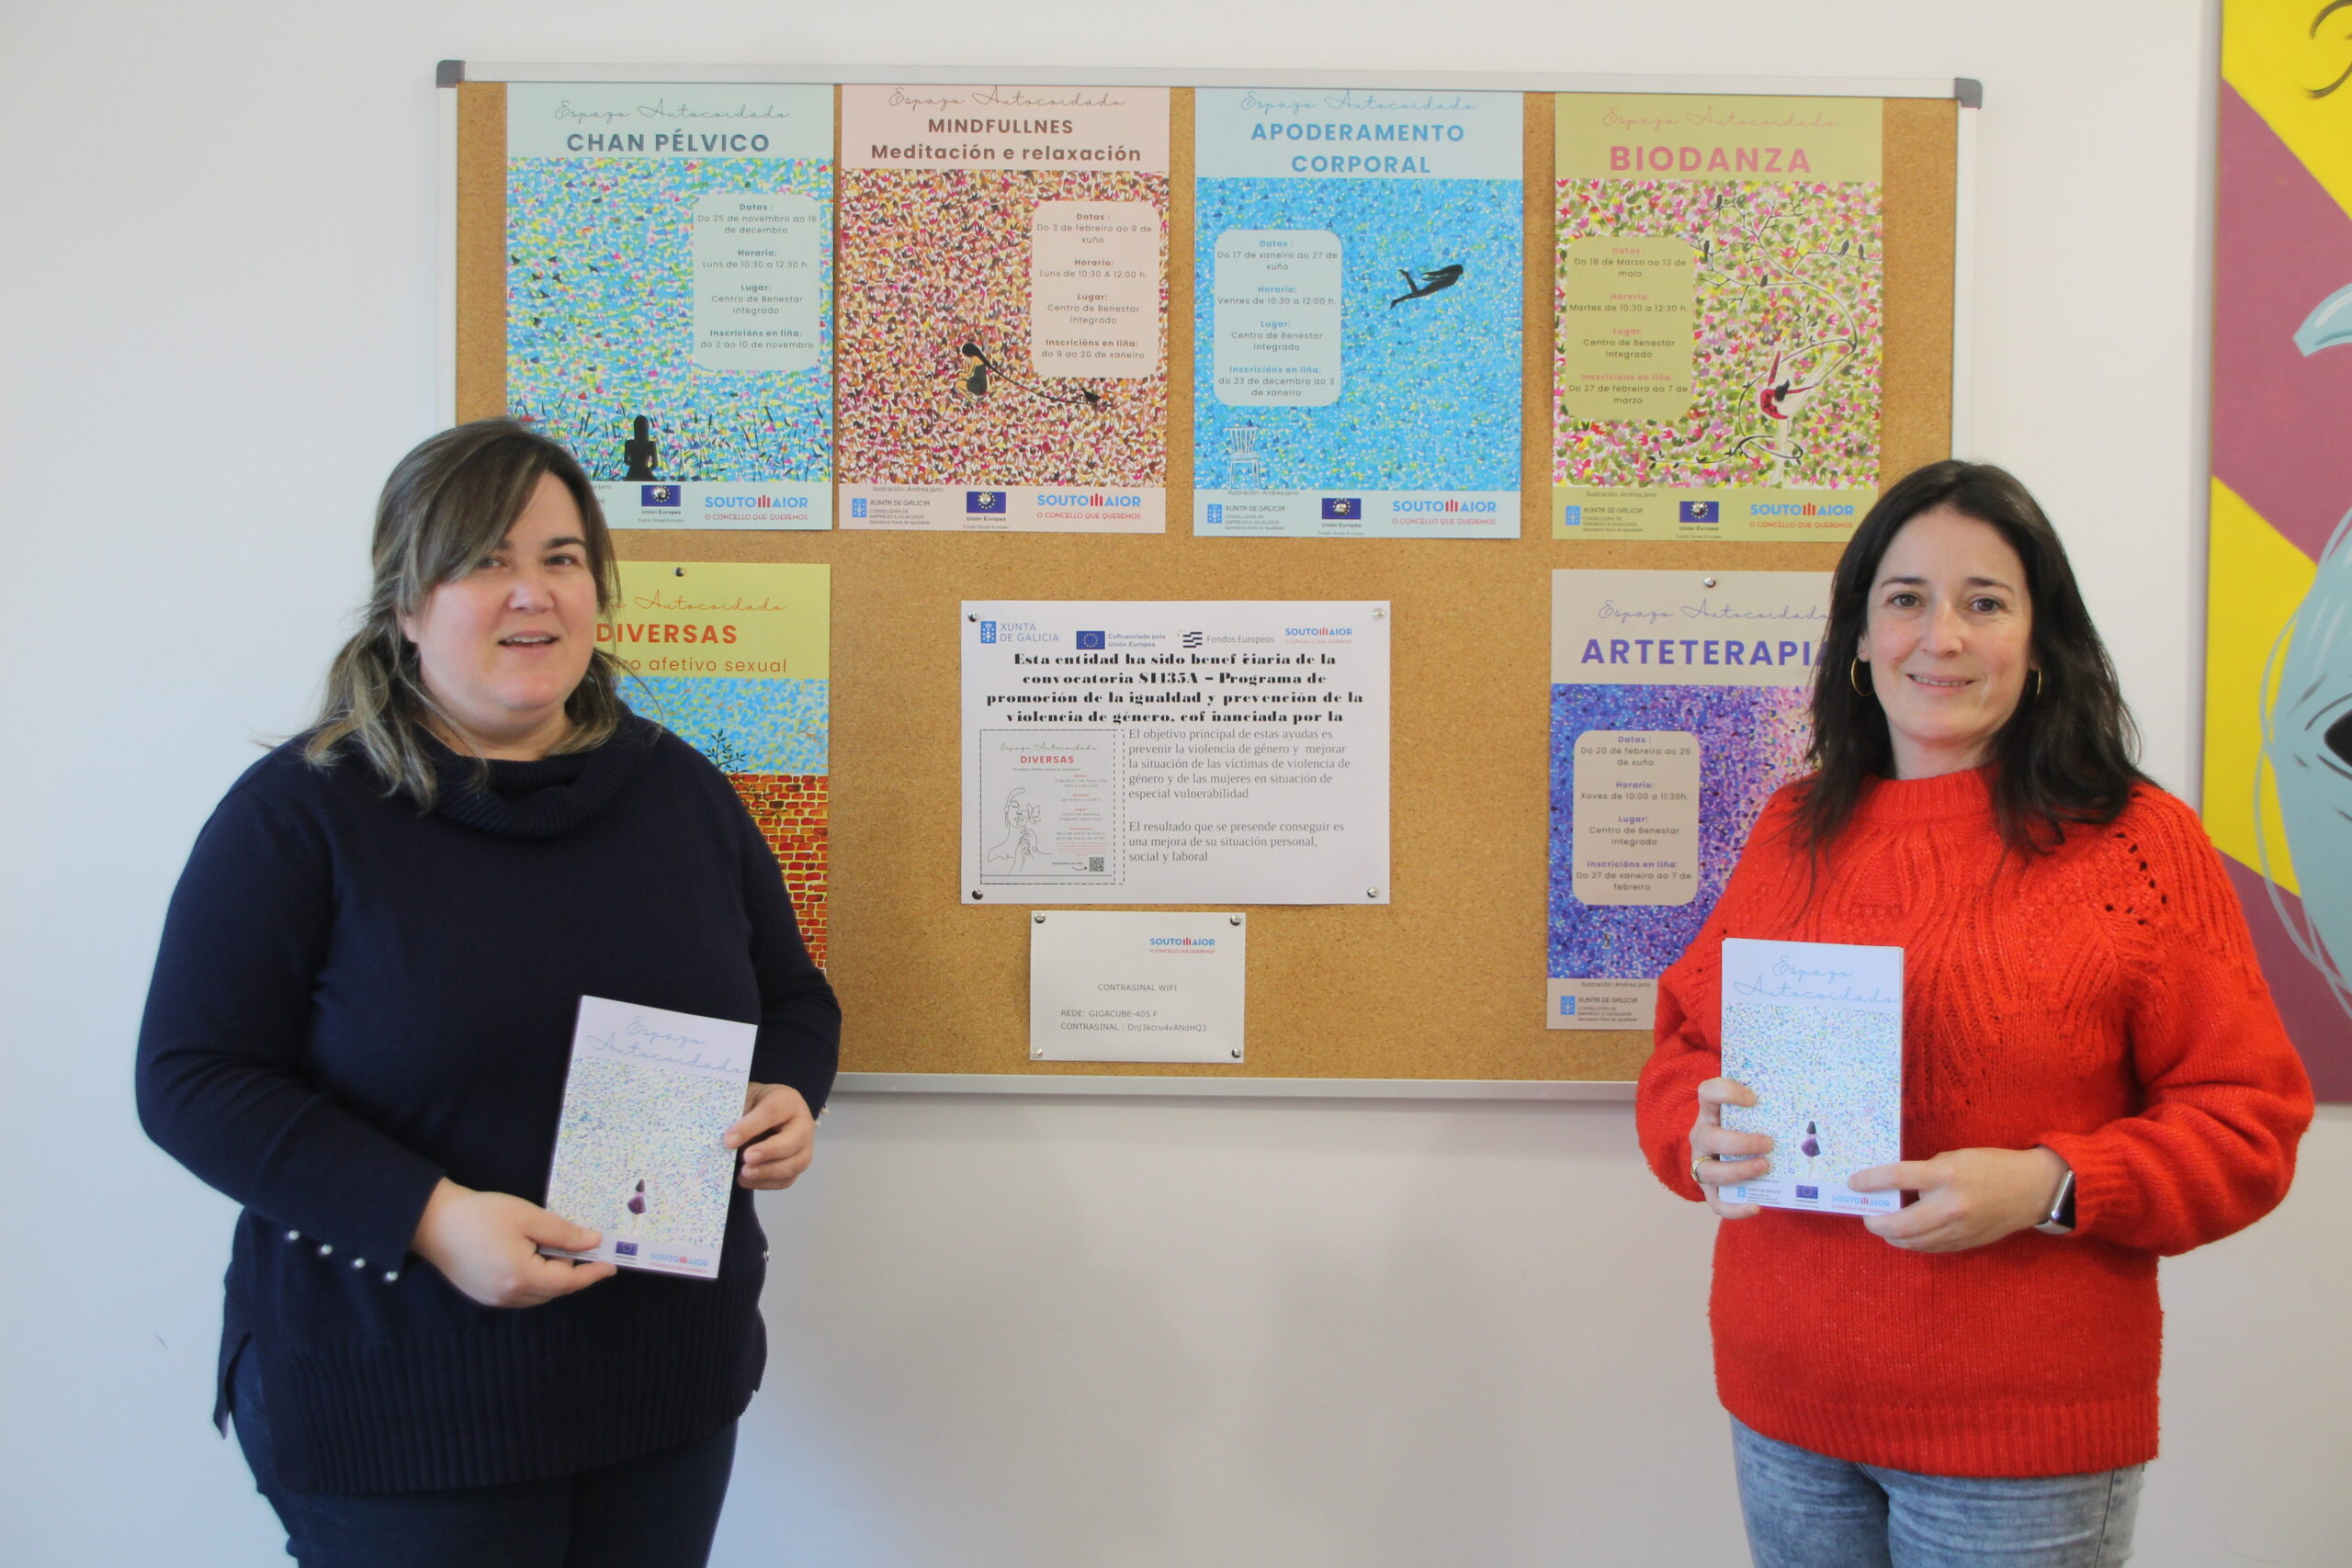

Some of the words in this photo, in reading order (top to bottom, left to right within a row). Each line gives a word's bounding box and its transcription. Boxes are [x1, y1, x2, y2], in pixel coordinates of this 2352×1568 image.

[928, 118, 1072, 133] MINDFULLNES
[1251, 123, 1463, 141] APODERAMENTO
[567, 133, 643, 152] CHAN
[655, 129, 769, 152] PÉLVICO
[872, 144, 994, 159] Meditación
[1003, 149, 1014, 159] e
[1023, 145, 1139, 160] relaxación
[1292, 155, 1430, 173] CORPORAL
[1610, 145, 1810, 174] BIODANZA
[1077, 294, 1107, 302] Lugar:
[733, 306, 779, 316] Integrado
[1070, 315, 1116, 326] Integrado
[1261, 321, 1291, 331] Lugar:
[1612, 328, 1644, 337] Lugar:
[1253, 343, 1299, 353] Integrado
[1606, 350, 1652, 360] Integrado
[1001, 622, 1036, 632] XUNTA
[596, 624, 737, 644] DIVERSAS
[1000, 633, 1012, 642] DE
[1016, 633, 1058, 642] GALICIA
[1580, 637, 1826, 667] ARTETERAPI
[649, 656, 716, 671] afetivo
[725, 658, 786, 672] sexual
[1014, 653, 1049, 664] Esta
[1055, 653, 1117, 664] entidad
[1125, 653, 1145, 664] ha
[1151, 653, 1184, 664] sido
[1295, 653, 1314, 663] de
[1321, 653, 1335, 663] la
[1023, 672, 1133, 682] convocatoria
[1219, 672, 1301, 685] Programa
[1306, 672, 1325, 682] de
[987, 692, 1077, 705] promoción
[1083, 692, 1102, 702] de
[1109, 692, 1123, 702] la
[1130, 692, 1200, 705] igualdad
[1207, 695, 1216, 705] y
[1224, 692, 1316, 705] prevención
[1323, 692, 1341, 702] de
[1349, 692, 1362, 702] la
[1007, 711, 1082, 721] violencia
[1088, 711, 1106, 721] de
[1113, 712, 1174, 724] género,
[1294, 715, 1321, 725] por
[1329, 710, 1341, 721] la
[1129, 728, 1139, 739] El
[1143, 728, 1185, 740] objetivo
[1189, 728, 1235, 740] principal
[1238, 728, 1250, 739] de
[1254, 730, 1279, 739] estas
[1283, 728, 1317, 740] ayudas
[1128, 744, 1171, 756] prevenir
[1175, 743, 1183, 753] la
[1188, 743, 1235, 753] violencia
[1238, 743, 1250, 753] de
[1254, 743, 1289, 756] género
[1293, 746, 1298, 755] y
[1306, 744, 1345, 755] mejorar
[1020, 755, 1073, 763] DIVERSAS
[1129, 758, 1137, 768] la
[1141, 758, 1187, 768] situación
[1191, 758, 1203, 768] de
[1207, 758, 1221, 768] las
[1225, 758, 1268, 768] víctimas
[1272, 758, 1283, 768] de
[1287, 758, 1334, 768] violencia
[1338, 758, 1350, 768] de
[1128, 773, 1163, 785] género
[1167, 776, 1173, 785] y
[1177, 773, 1189, 783] de
[1193, 773, 1206, 783] las
[1210, 773, 1251, 785] mujeres
[1270, 773, 1316, 783] situación
[1319, 773, 1332, 783] de
[1128, 788, 1170, 800] especial
[1174, 788, 1248, 797] vulnerabilidad
[1619, 816, 1648, 824] Lugar:
[1129, 821, 1139, 830] El
[1144, 820, 1191, 830] resultado
[1194, 824, 1213, 833] que
[1230, 821, 1276, 833] presende
[1279, 821, 1329, 833] conseguir
[1151, 837, 1186, 848] mejora
[1190, 836, 1202, 846] de
[1220, 836, 1266, 846] situación
[1271, 836, 1317, 848] personal,
[1611, 837, 1657, 848] Integrado
[1128, 851, 1158, 861] social
[1162, 853, 1168, 863] y
[1172, 851, 1207, 861] laboral
[1158, 984, 1178, 992] WIFI
[1060, 1010, 1086, 1018] REDE:
[1089, 1010, 1149, 1018] GIGACUBE-405
[1060, 1021, 1118, 1031] CONTRASINAL
